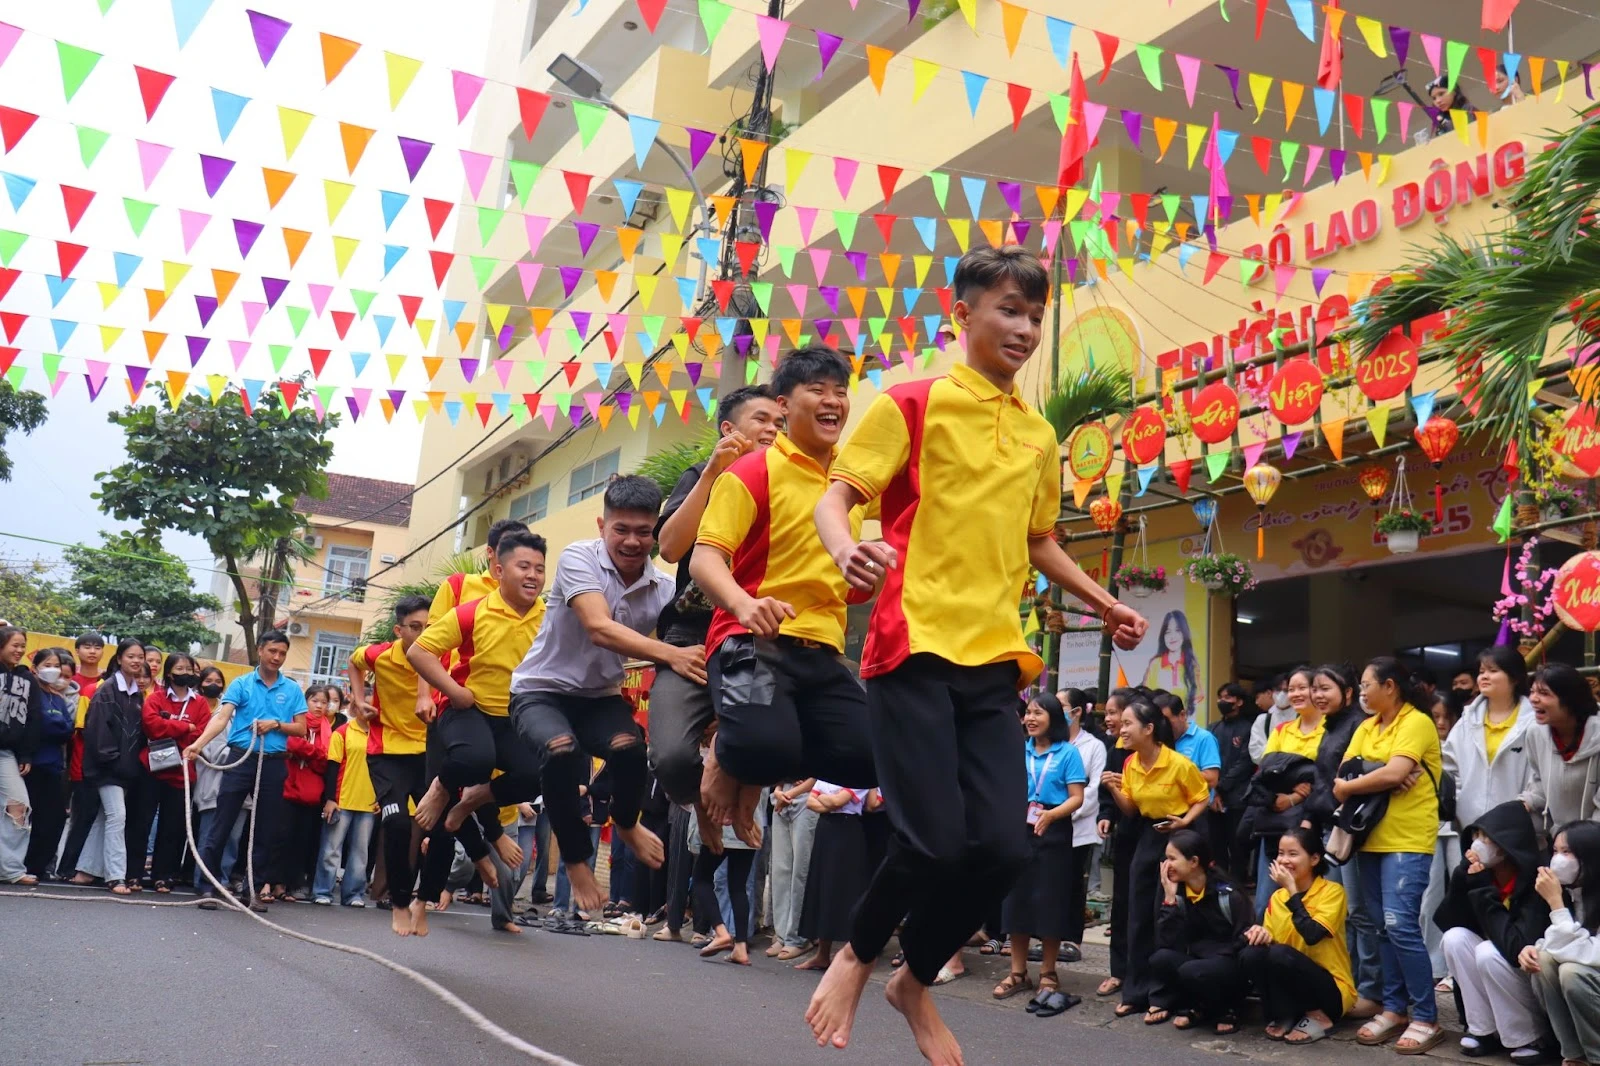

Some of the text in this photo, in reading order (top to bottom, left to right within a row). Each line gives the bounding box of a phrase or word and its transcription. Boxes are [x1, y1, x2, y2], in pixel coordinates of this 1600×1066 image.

[1304, 199, 1382, 261] LAO
[1392, 141, 1528, 229] ĐỘNG
[1270, 377, 1320, 411] Việt
[1361, 351, 1411, 384] 2025
